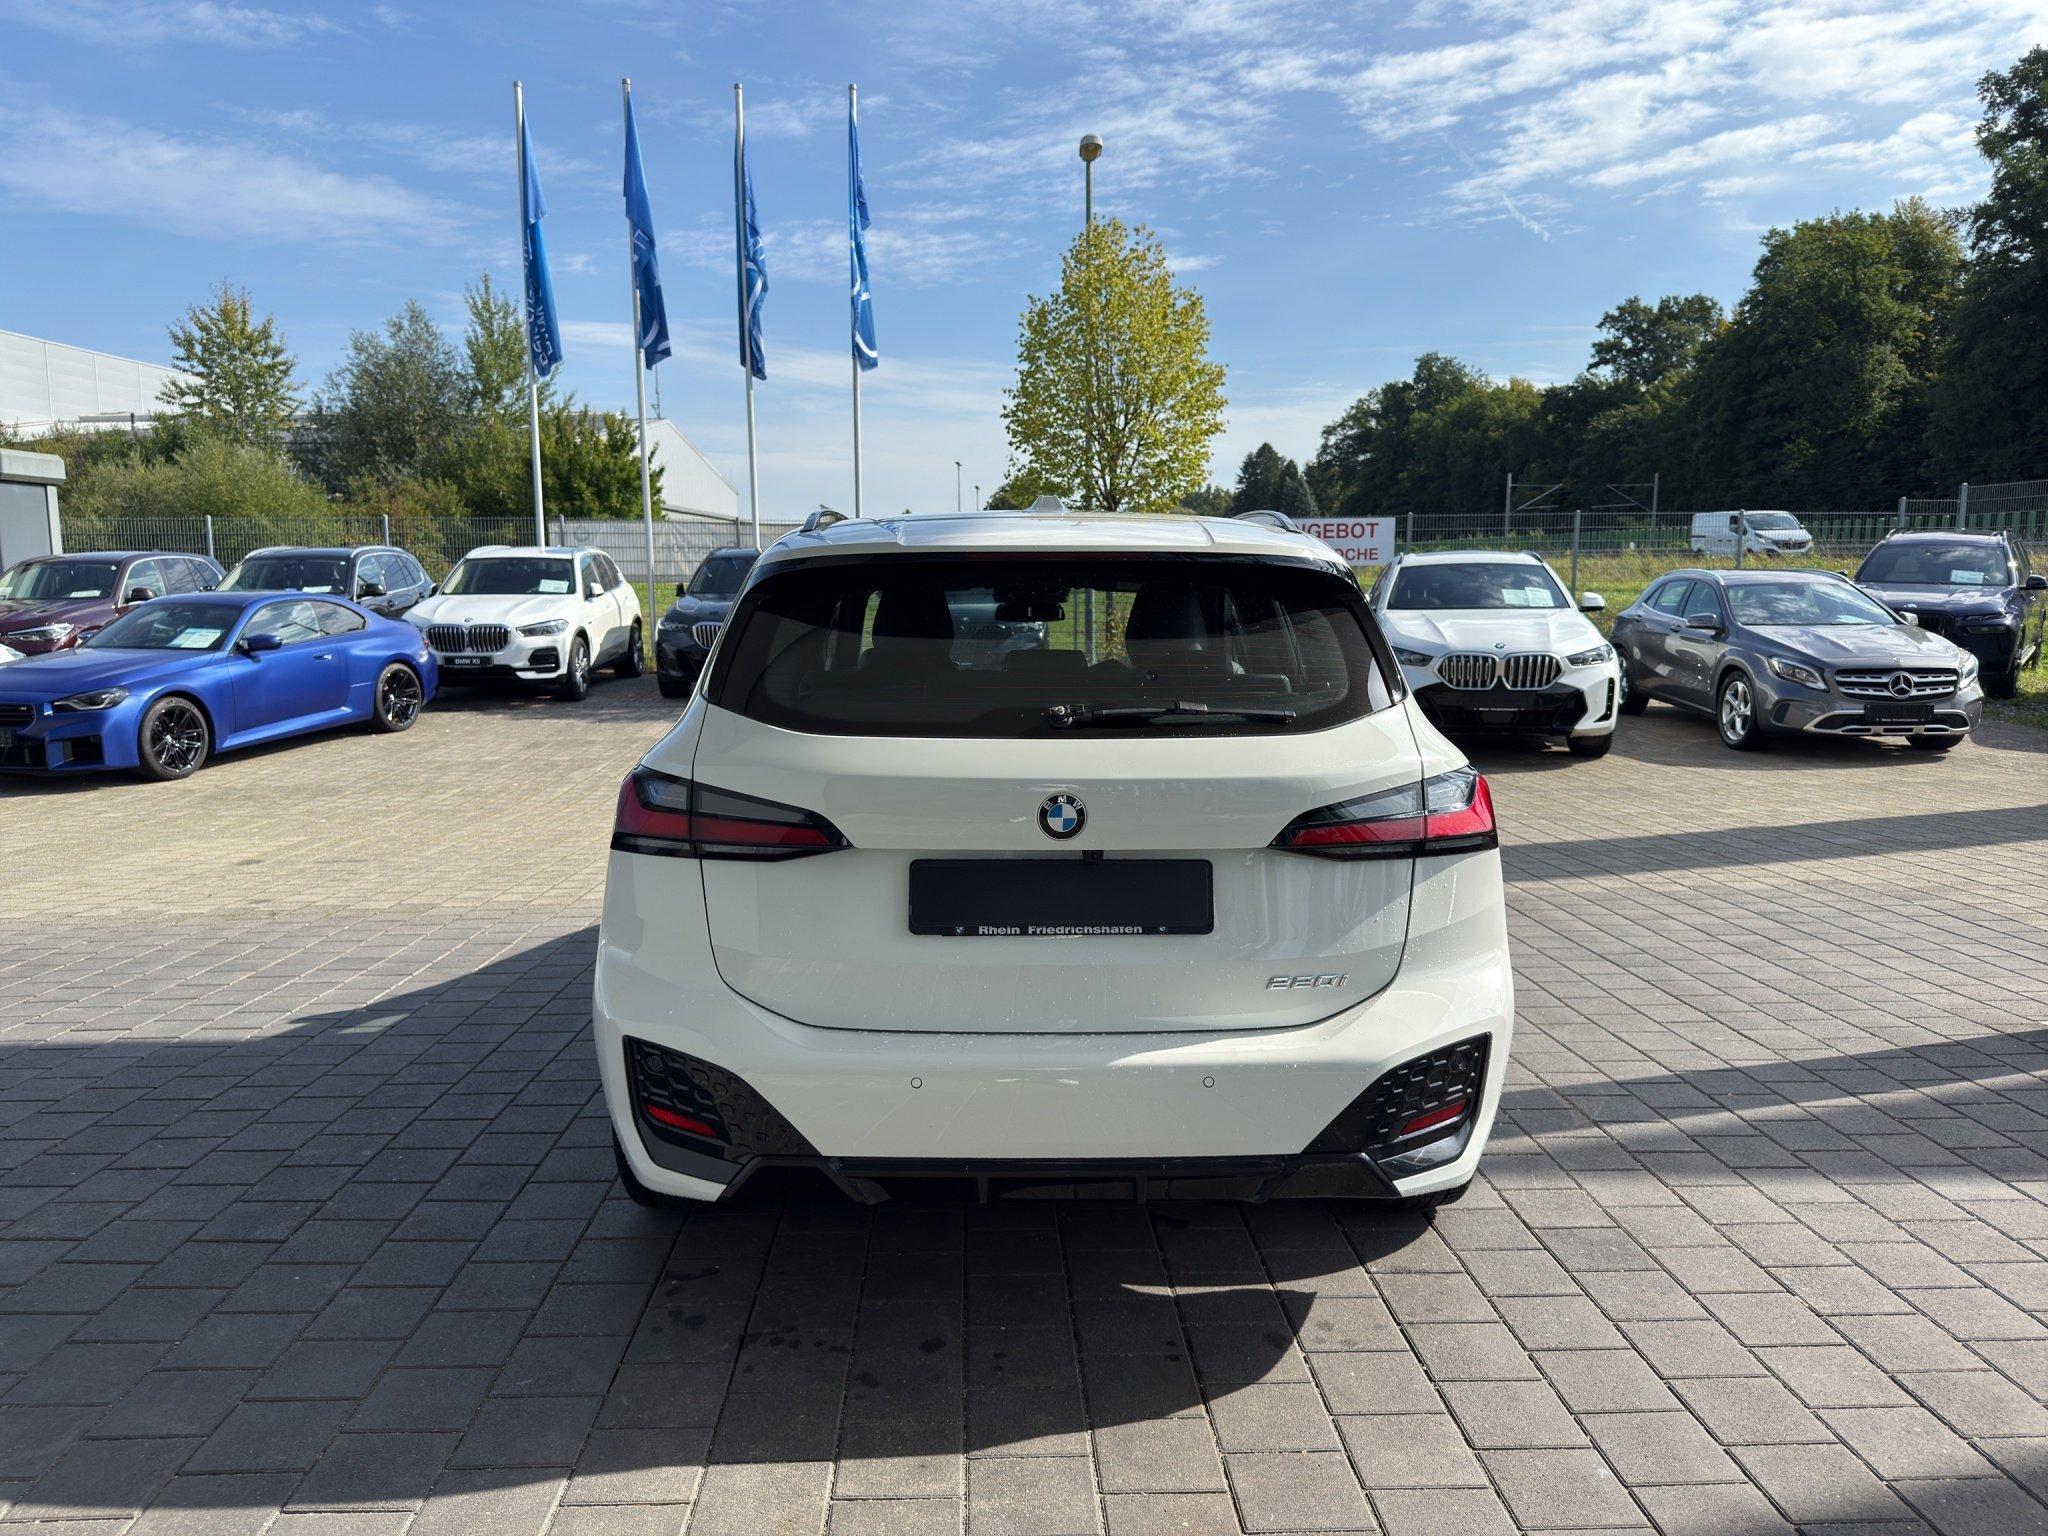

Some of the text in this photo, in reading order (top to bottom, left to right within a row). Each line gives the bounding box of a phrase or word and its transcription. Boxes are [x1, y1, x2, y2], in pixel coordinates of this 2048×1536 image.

[1301, 523, 1379, 539] GEBOT
[1043, 795, 1083, 810] BMW
[978, 925, 1143, 935] Rhein Friedrichshafen
[1265, 974, 1350, 990] 220i
